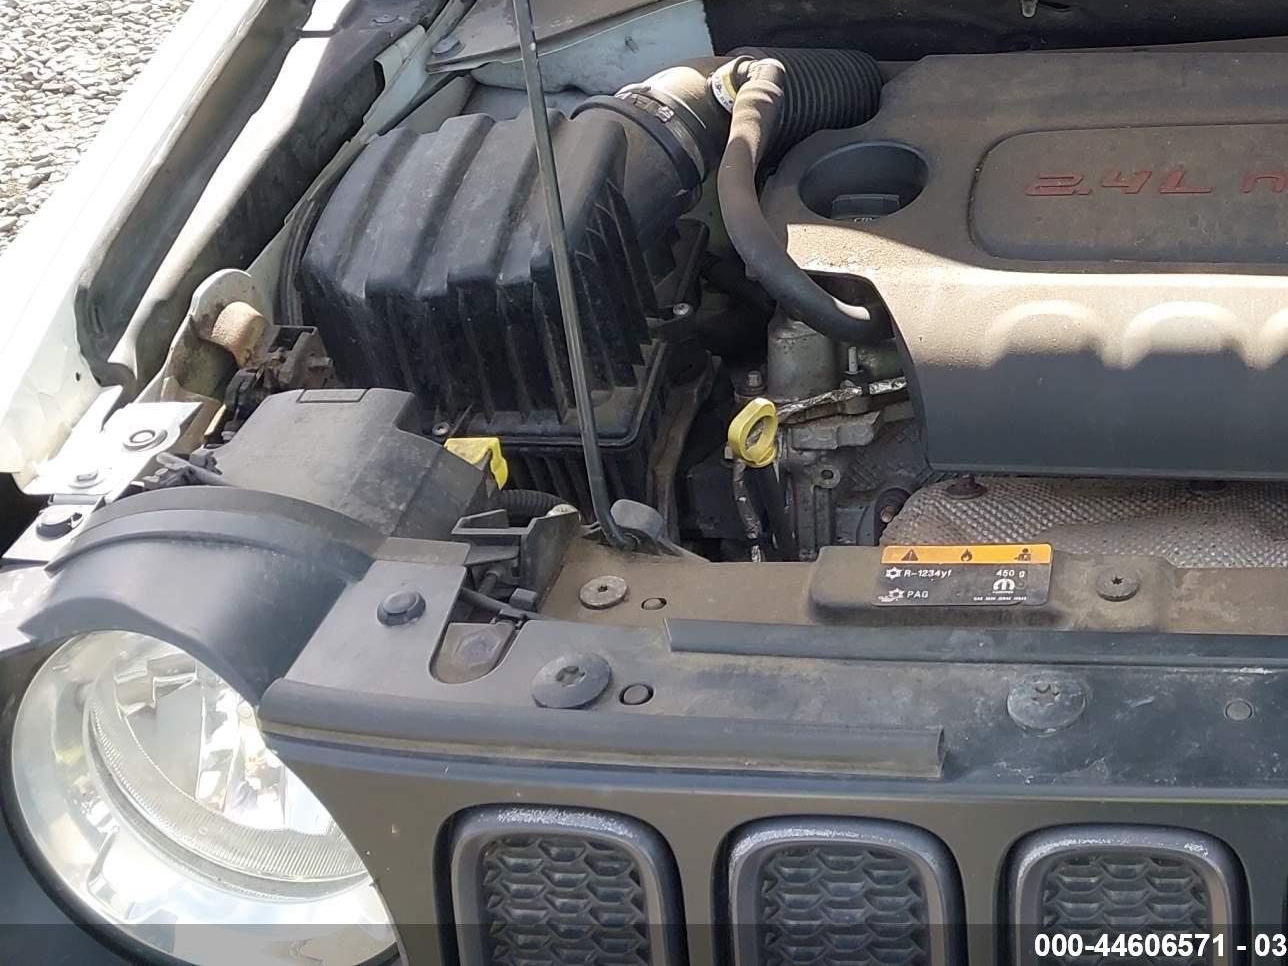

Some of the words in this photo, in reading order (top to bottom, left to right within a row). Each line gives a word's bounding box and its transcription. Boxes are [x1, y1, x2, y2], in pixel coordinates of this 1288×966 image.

[1026, 169, 1214, 196] 2.4L
[903, 569, 952, 579] R-1234yf
[996, 569, 1015, 577] 450
[906, 590, 929, 598] PAG
